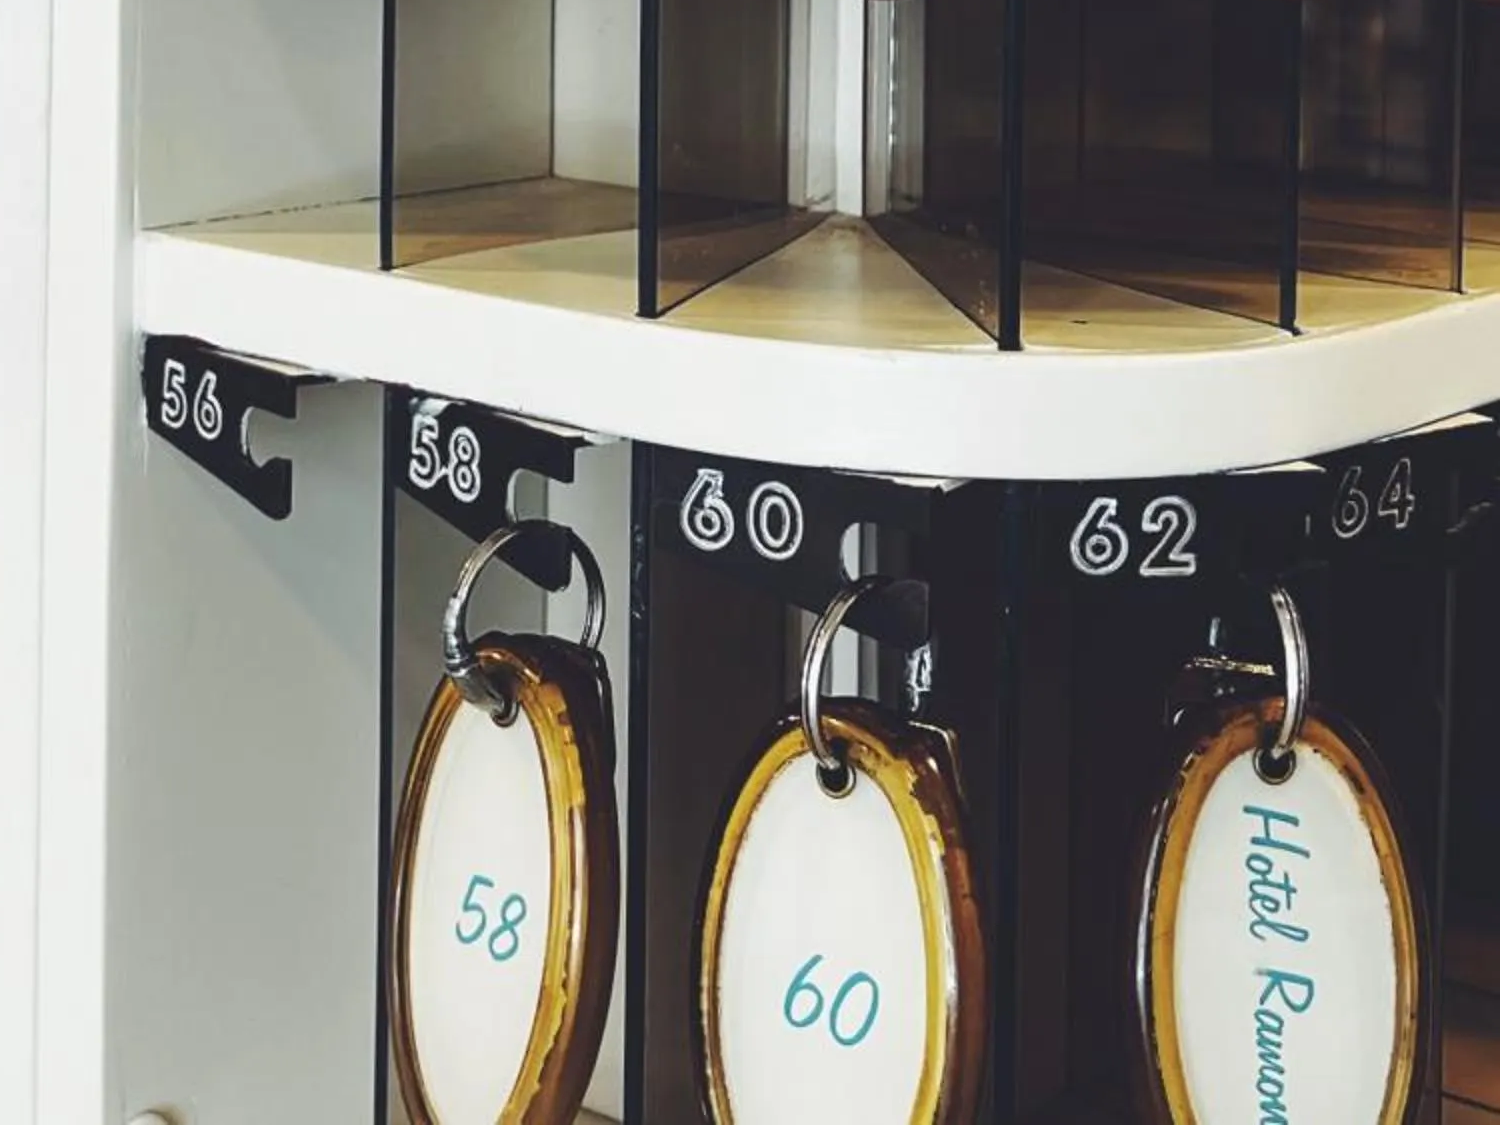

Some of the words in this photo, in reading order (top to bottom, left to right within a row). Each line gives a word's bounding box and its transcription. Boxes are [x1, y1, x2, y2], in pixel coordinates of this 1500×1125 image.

[160, 359, 223, 441] 56
[409, 413, 481, 503] 58
[1331, 457, 1416, 538] 64
[680, 468, 804, 561] 60
[1069, 495, 1197, 577] 62
[1243, 805, 1311, 943] Hotel
[455, 875, 528, 962] 58
[783, 953, 881, 1047] 60
